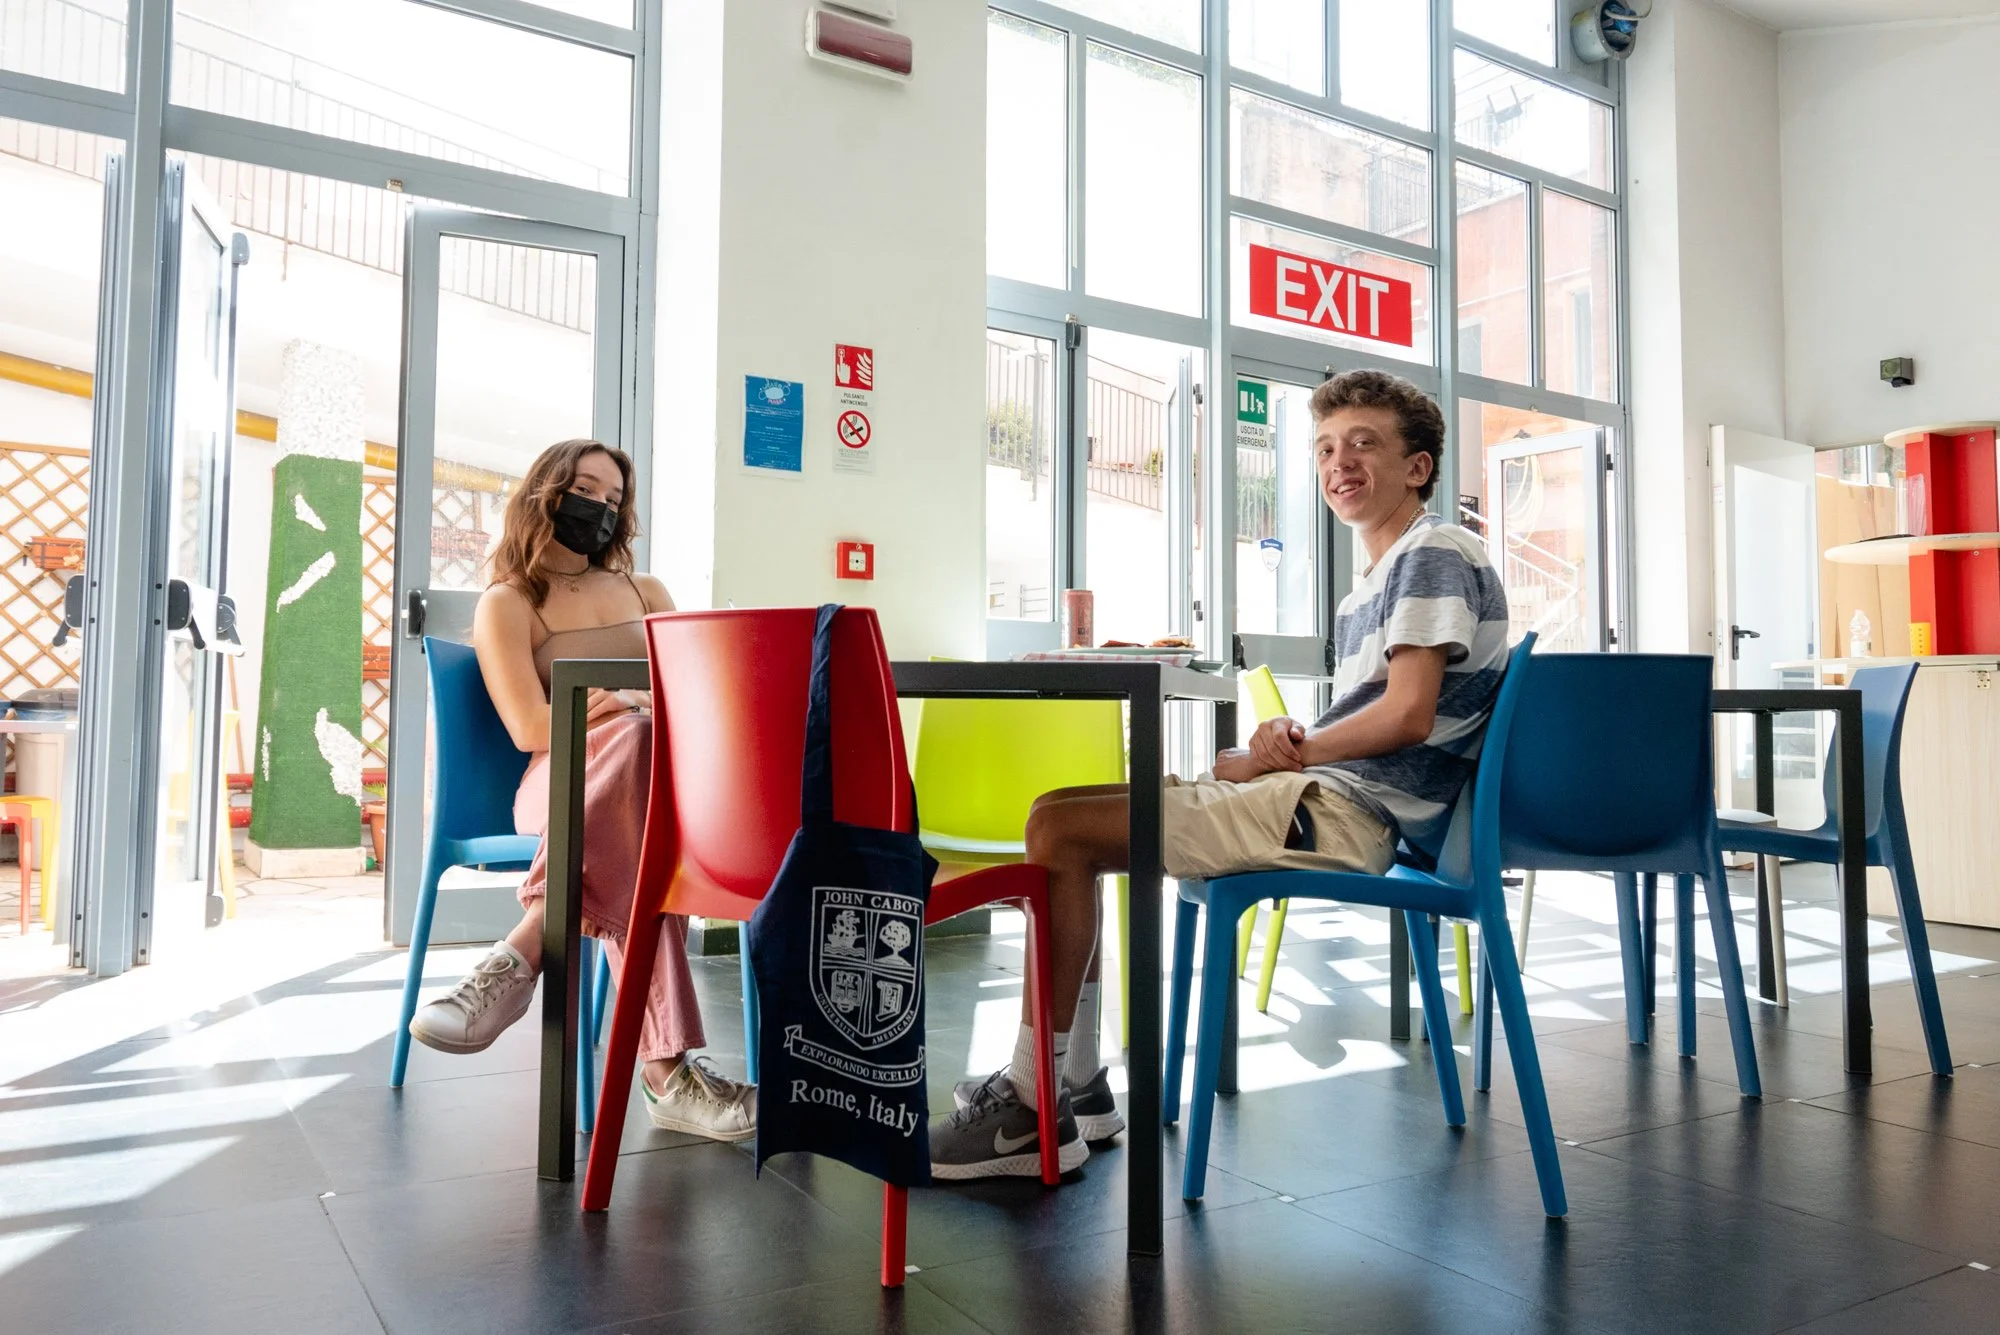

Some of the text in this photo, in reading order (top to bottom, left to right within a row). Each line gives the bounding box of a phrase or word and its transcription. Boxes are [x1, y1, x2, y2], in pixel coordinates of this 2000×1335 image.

[1277, 255, 1389, 337] EXIT
[1237, 435, 1267, 448] EMERGENZA
[1241, 425, 1257, 435] USCITA
[823, 891, 920, 915] JOHN CABOT
[872, 1010, 915, 1045] AMERICANA
[800, 1044, 919, 1082] EXPLORANDO EXCELLO
[789, 1079, 919, 1138] Rome, Italy
